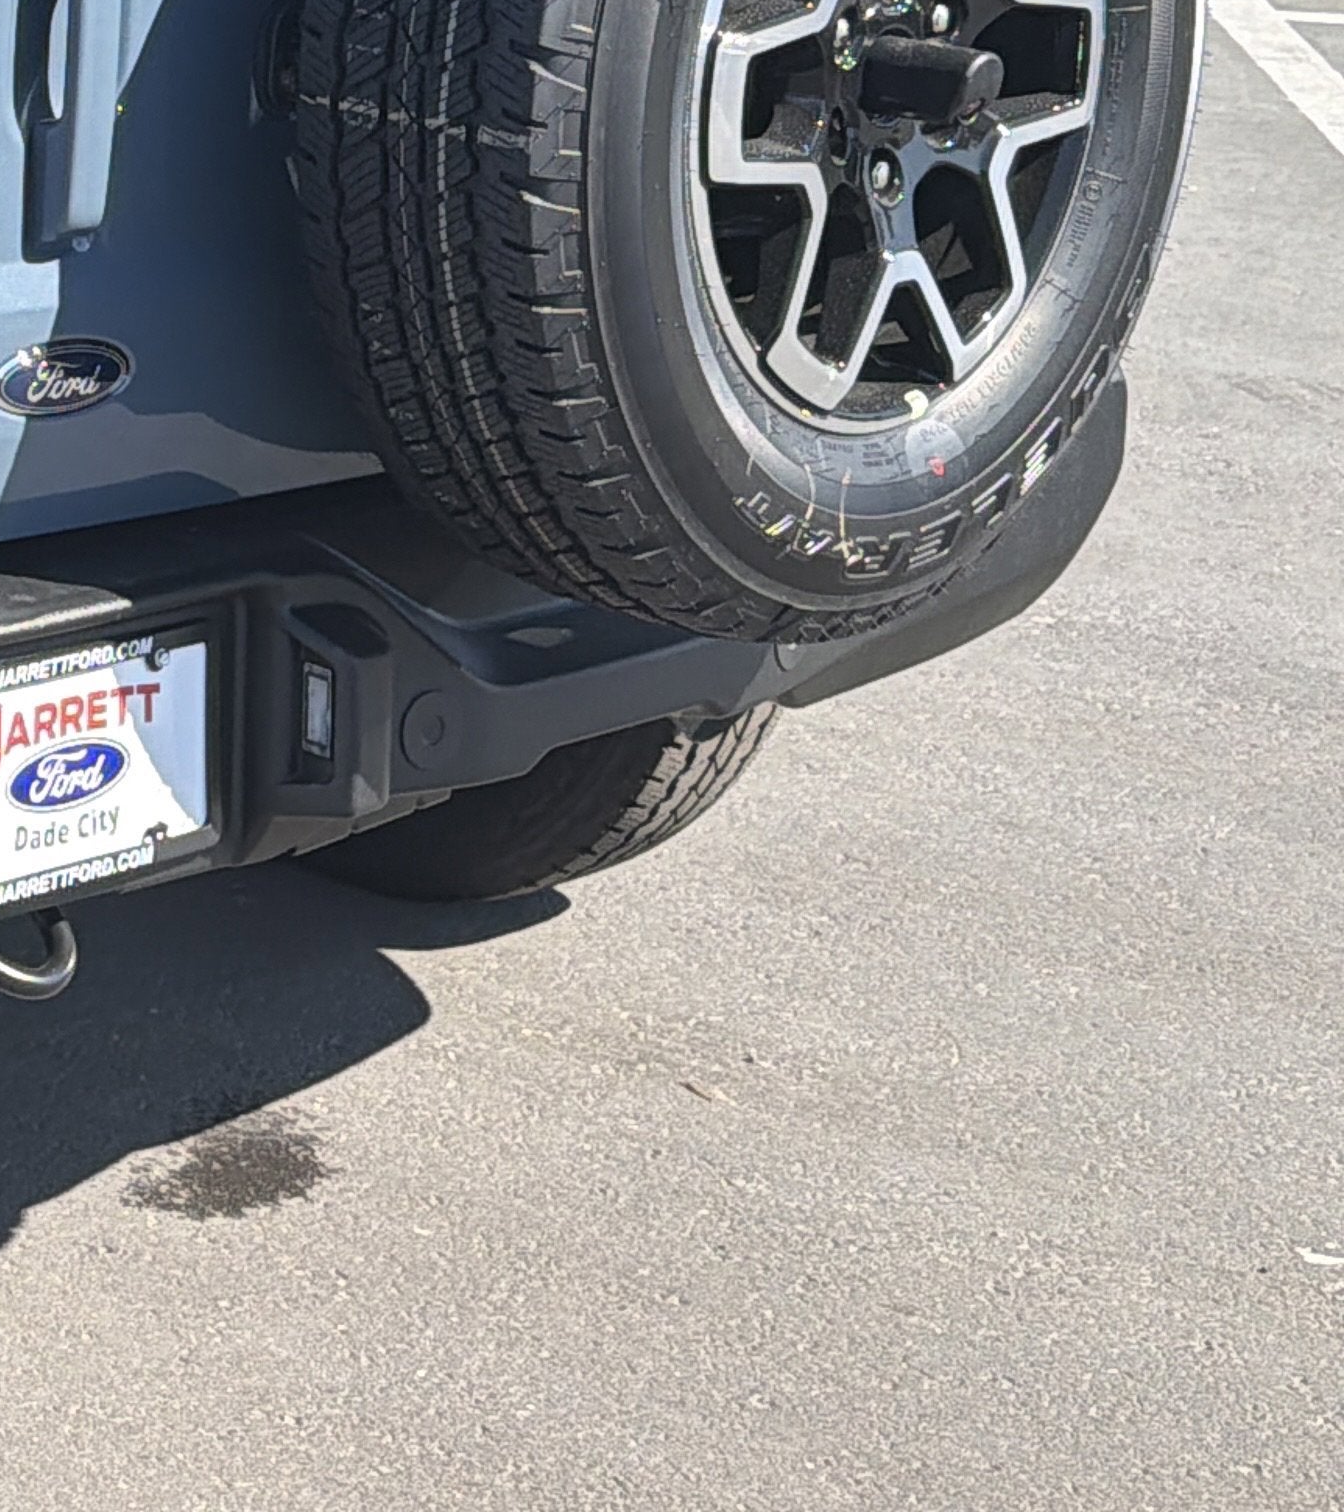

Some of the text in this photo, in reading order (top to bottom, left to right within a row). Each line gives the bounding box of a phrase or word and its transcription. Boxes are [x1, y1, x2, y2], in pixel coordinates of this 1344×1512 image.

[27, 361, 101, 403] Ford
[29, 748, 105, 803] Ford
[15, 806, 121, 851] Dade City
